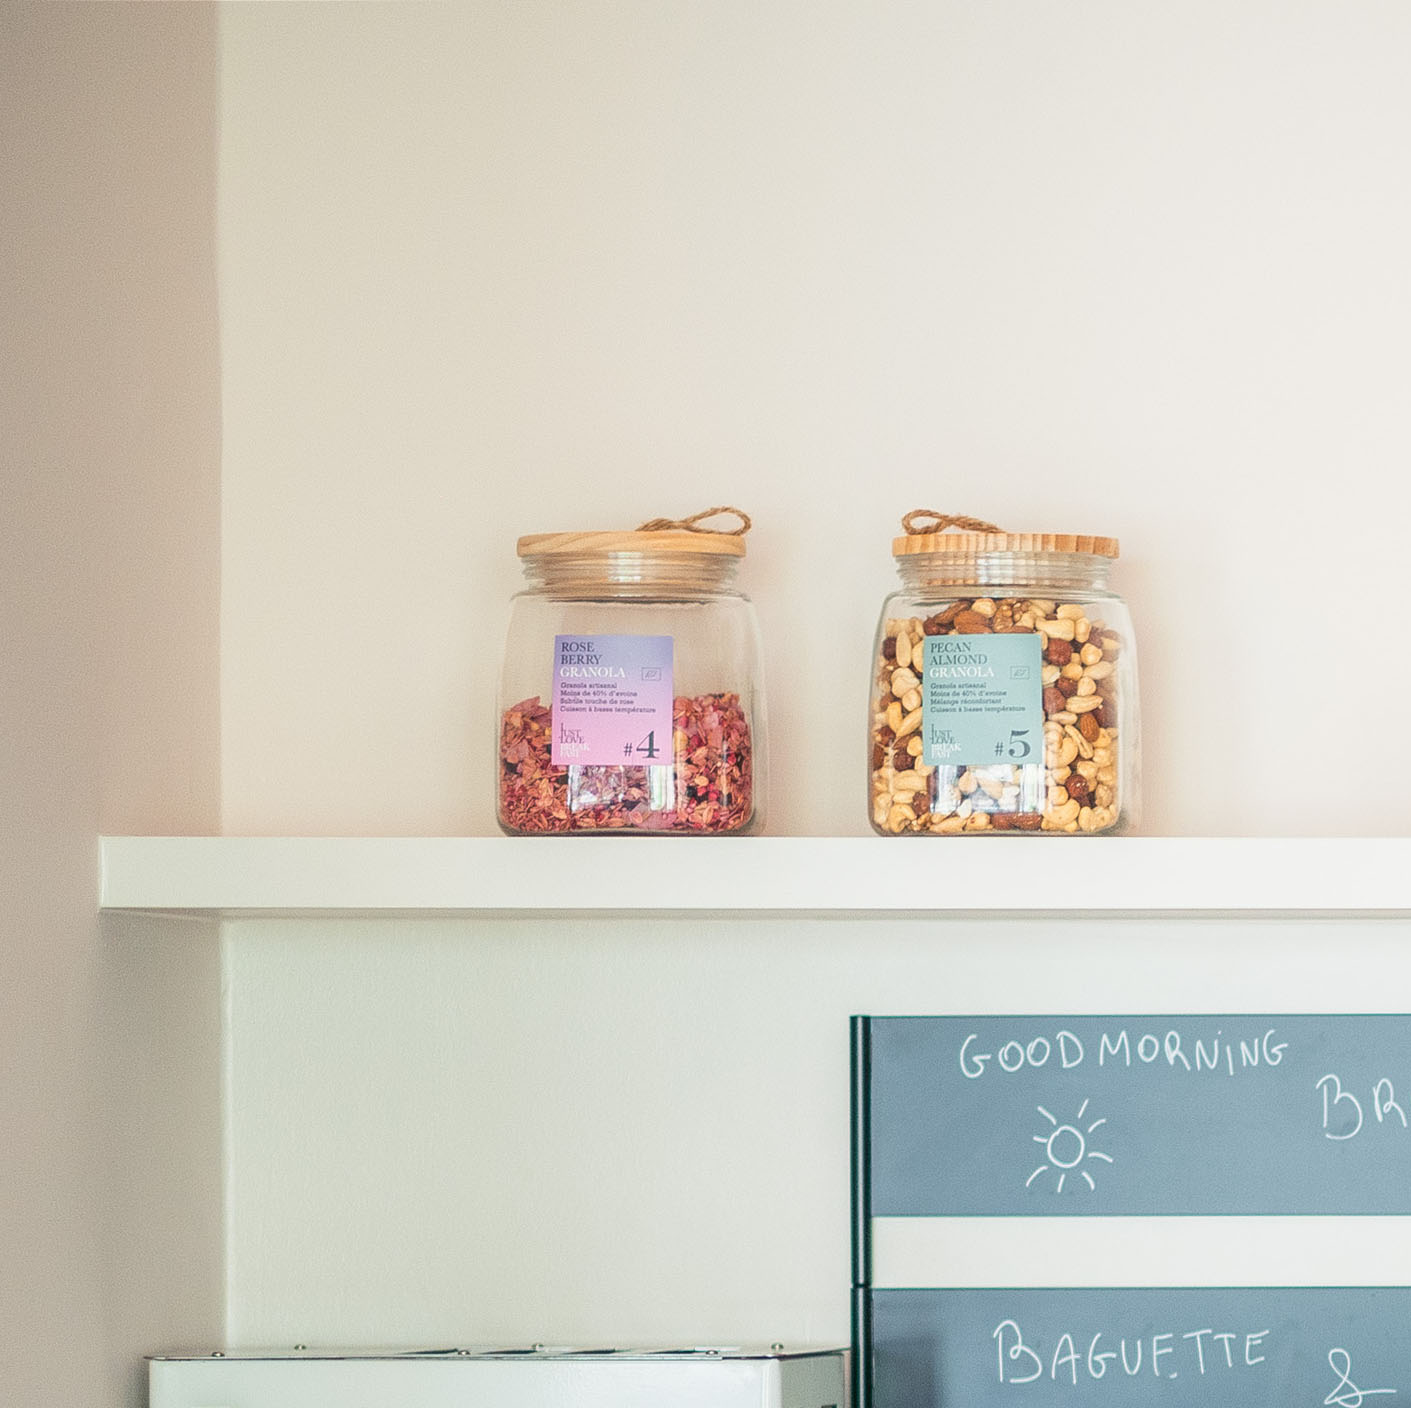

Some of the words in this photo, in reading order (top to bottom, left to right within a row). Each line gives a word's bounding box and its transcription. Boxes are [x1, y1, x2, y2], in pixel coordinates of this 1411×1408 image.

[560, 641, 594, 653] ROSE
[930, 641, 972, 653] PECAN
[560, 654, 602, 665] BERRY
[930, 654, 988, 666] ALMOND
[560, 666, 626, 678] GRANOLA
[929, 666, 995, 678] GRANOLA
[930, 682, 957, 690] Granola
[561, 736, 585, 744] LOVE
[623, 730, 660, 759] #4
[994, 729, 1031, 759] #5
[960, 1031, 1084, 1078] GOOD
[992, 1318, 1271, 1385] BAGUETTE
